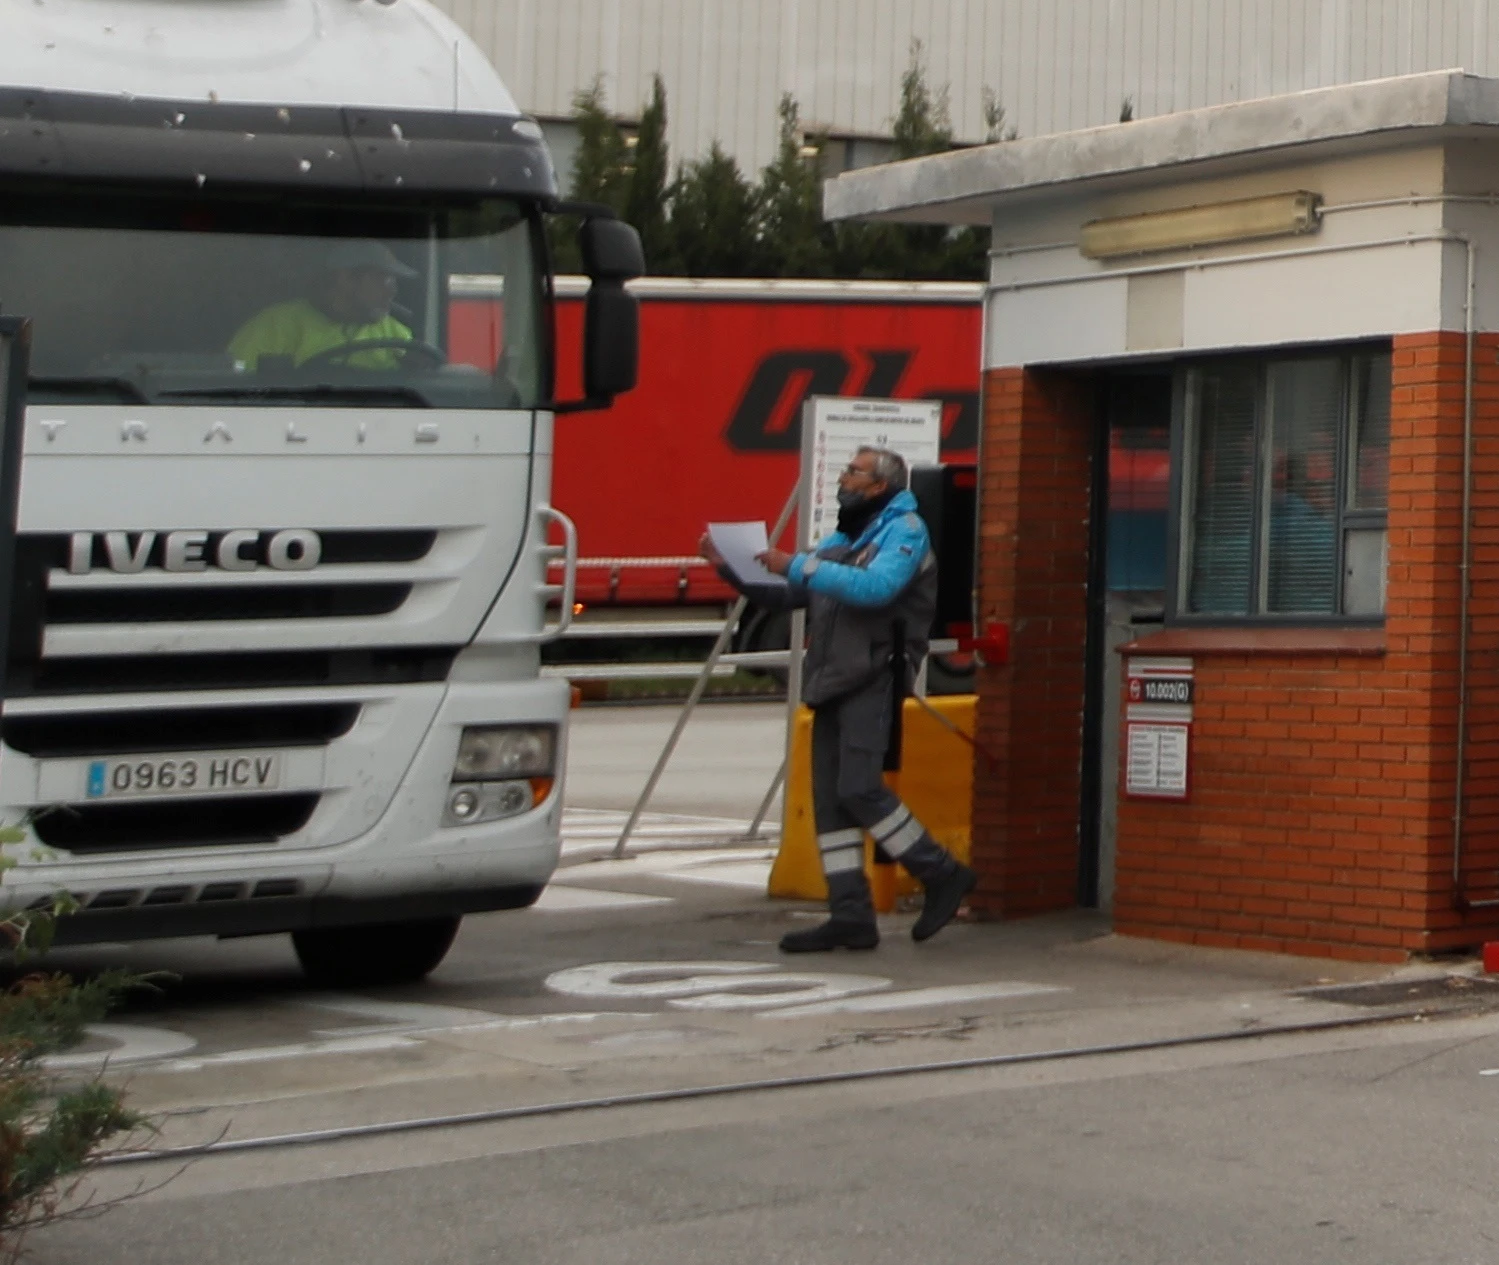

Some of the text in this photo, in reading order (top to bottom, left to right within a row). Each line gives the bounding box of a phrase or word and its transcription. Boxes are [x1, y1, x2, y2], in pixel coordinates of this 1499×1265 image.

[40, 419, 439, 443] TRALIS
[70, 529, 322, 574] IVECO
[112, 756, 272, 791] 0963 HCV
